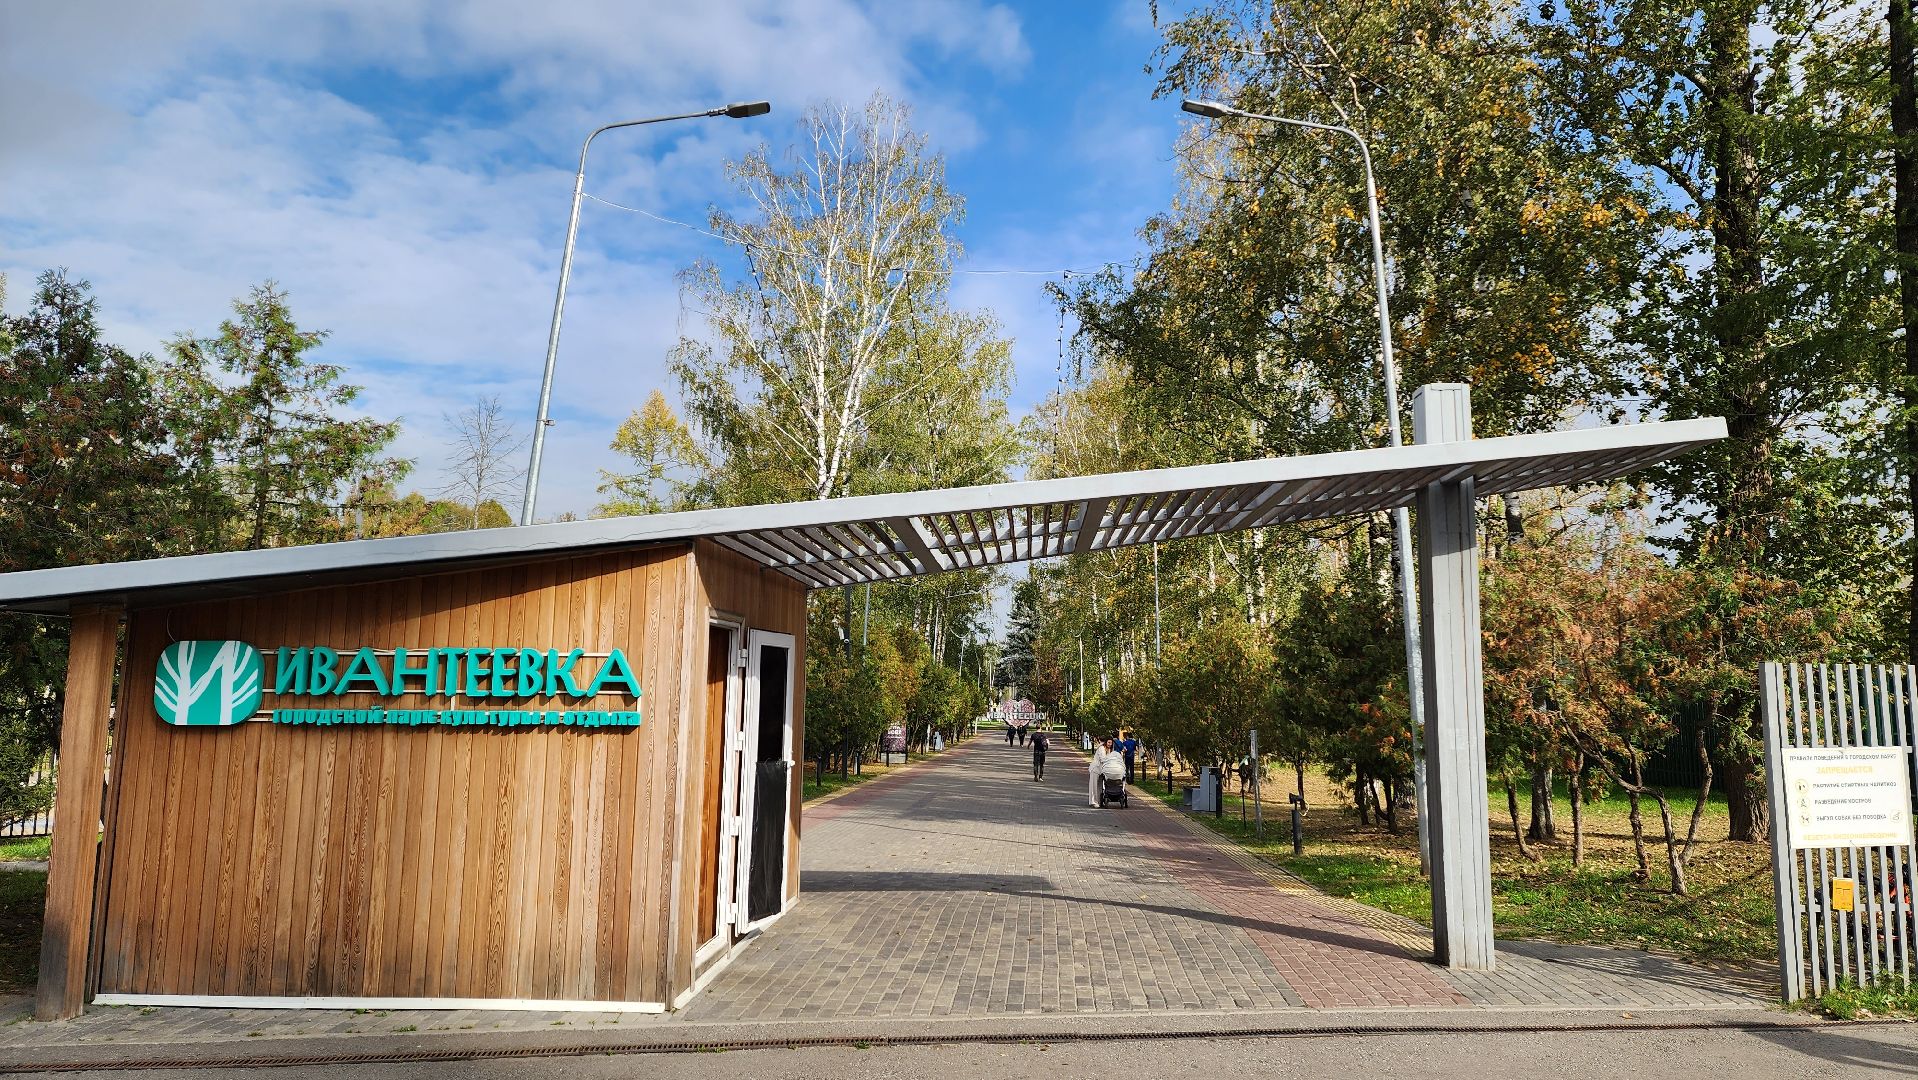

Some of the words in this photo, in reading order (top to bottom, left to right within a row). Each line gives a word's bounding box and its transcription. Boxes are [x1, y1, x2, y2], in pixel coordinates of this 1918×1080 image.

[274, 646, 642, 700] ИВАНТЕЕВКА
[272, 705, 384, 726] городской
[386, 709, 438, 727] парк
[439, 710, 541, 727] культуры
[544, 711, 560, 725] и
[562, 711, 641, 728] отдыха
[1817, 765, 1873, 774] ЗАПРЕЩАЕТСЯ
